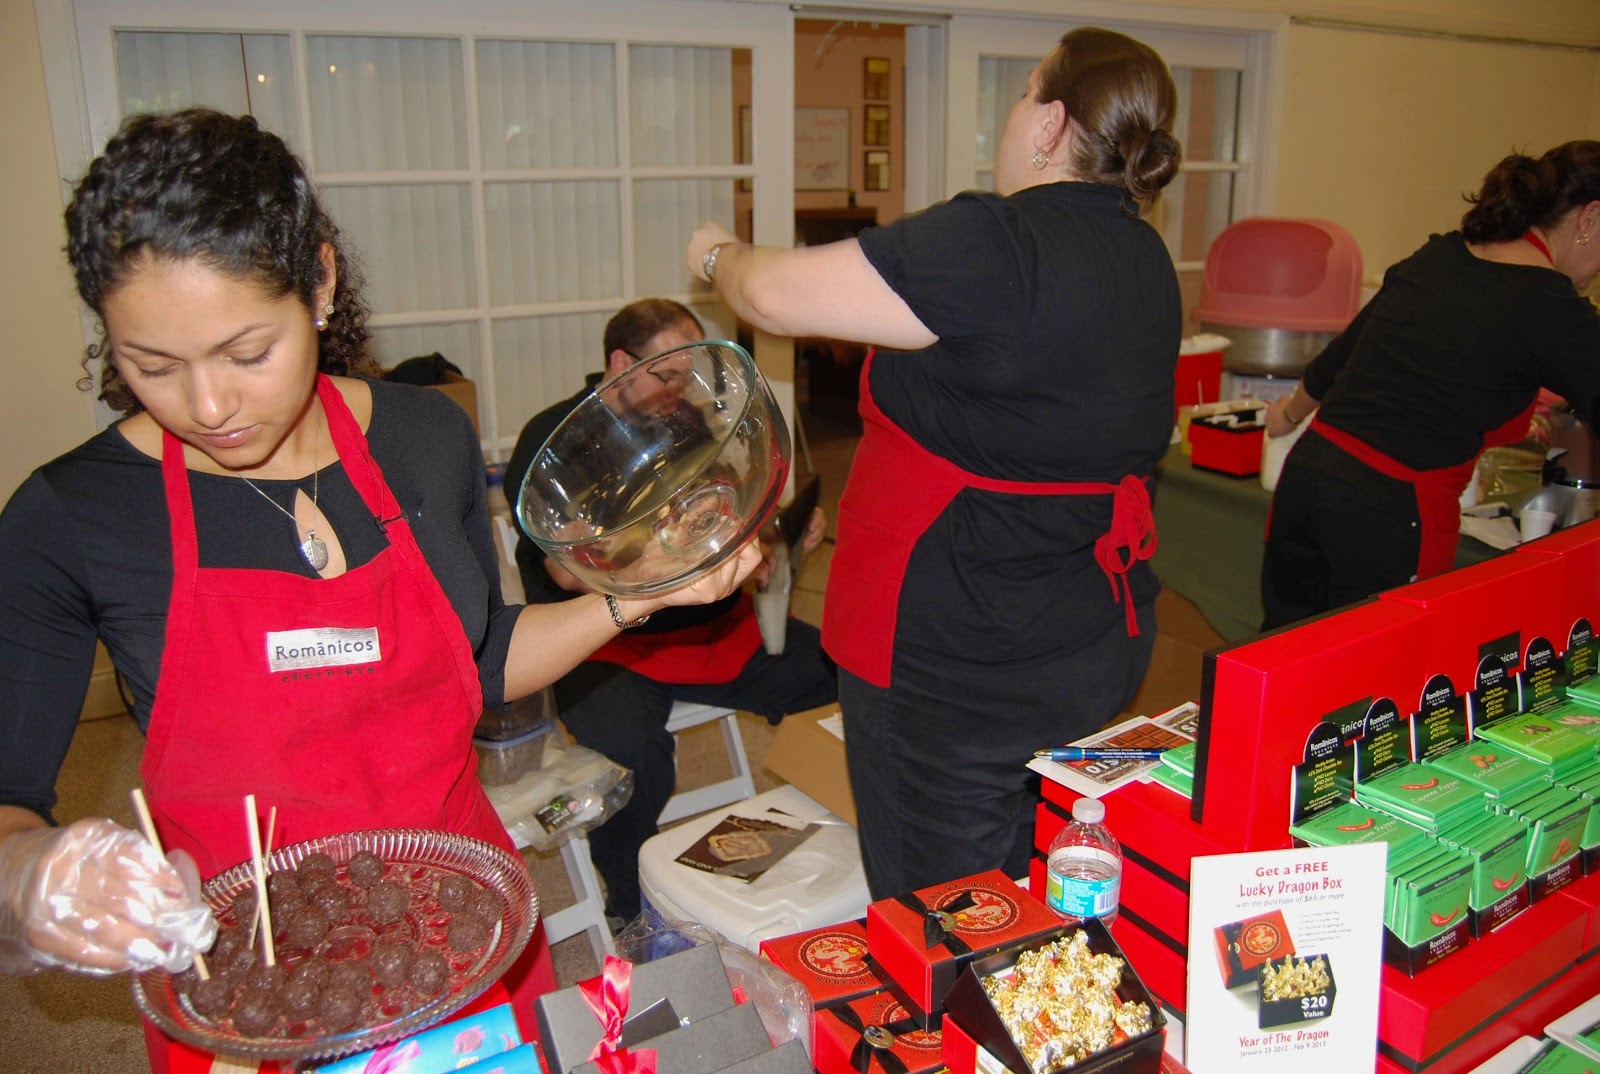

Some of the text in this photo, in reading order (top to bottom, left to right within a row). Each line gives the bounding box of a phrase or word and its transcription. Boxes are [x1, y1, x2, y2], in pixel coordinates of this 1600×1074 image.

[275, 640, 374, 660] Romānicos
[282, 666, 375, 682] chocolate
[1255, 861, 1328, 877] Get a FREE
[945, 882, 994, 890] Dragon
[1240, 877, 1342, 897] Lucky Dragon Box
[1251, 900, 1262, 908] the
[1264, 897, 1293, 907] purchase
[1301, 995, 1328, 1010] $20
[1303, 1009, 1324, 1018] Value
[1239, 1030, 1329, 1048] Year of The Dragon
[1240, 1049, 1262, 1057] January
